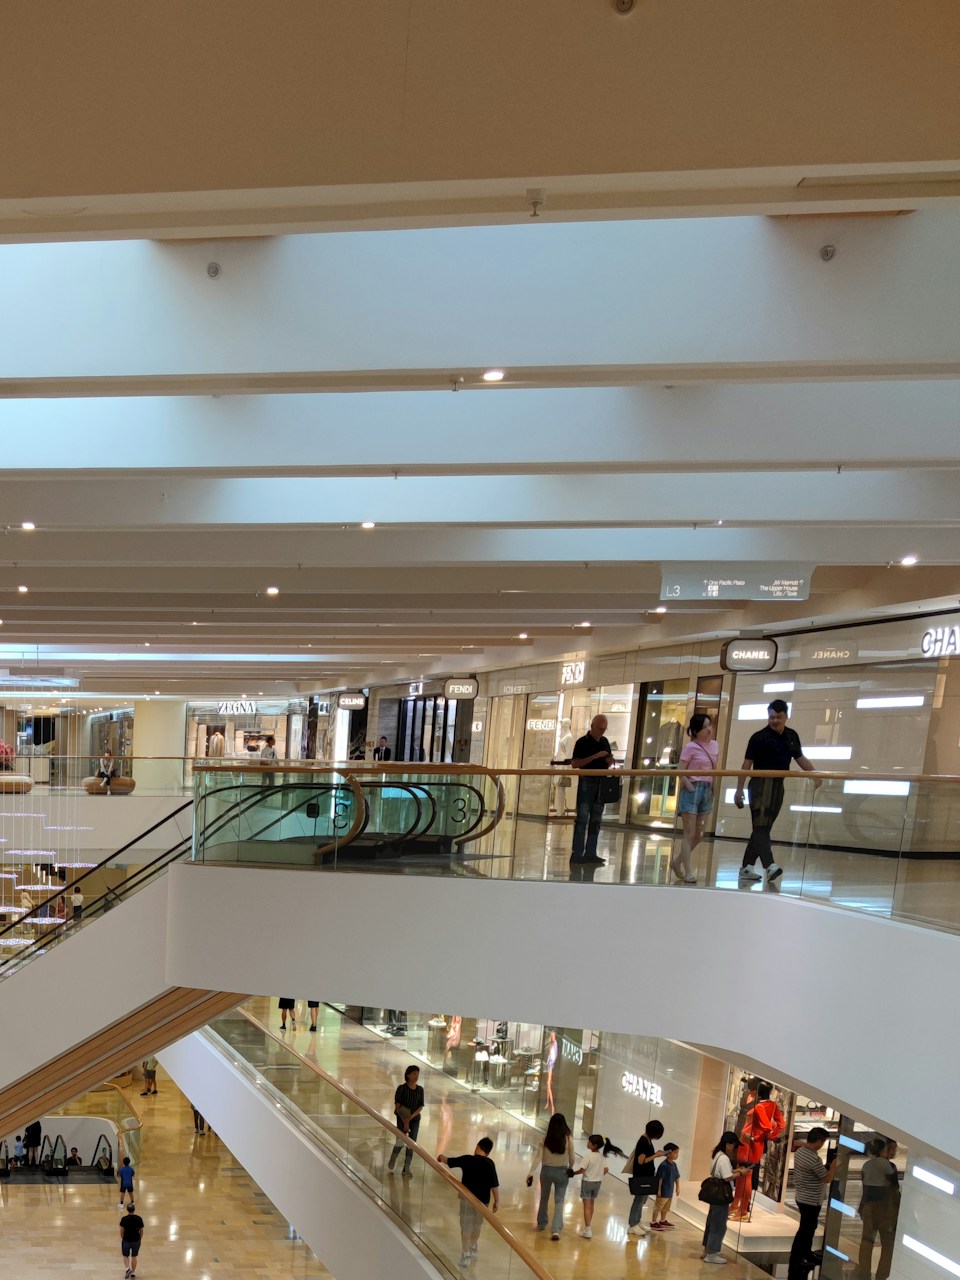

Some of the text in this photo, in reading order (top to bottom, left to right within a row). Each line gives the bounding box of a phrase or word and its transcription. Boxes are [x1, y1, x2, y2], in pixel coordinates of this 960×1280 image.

[666, 585, 680, 597] L3
[732, 651, 770, 660] CHANEL
[449, 685, 473, 695] FENDI
[217, 701, 255, 715] ZEGNA
[621, 1071, 664, 1108] CHANEL
